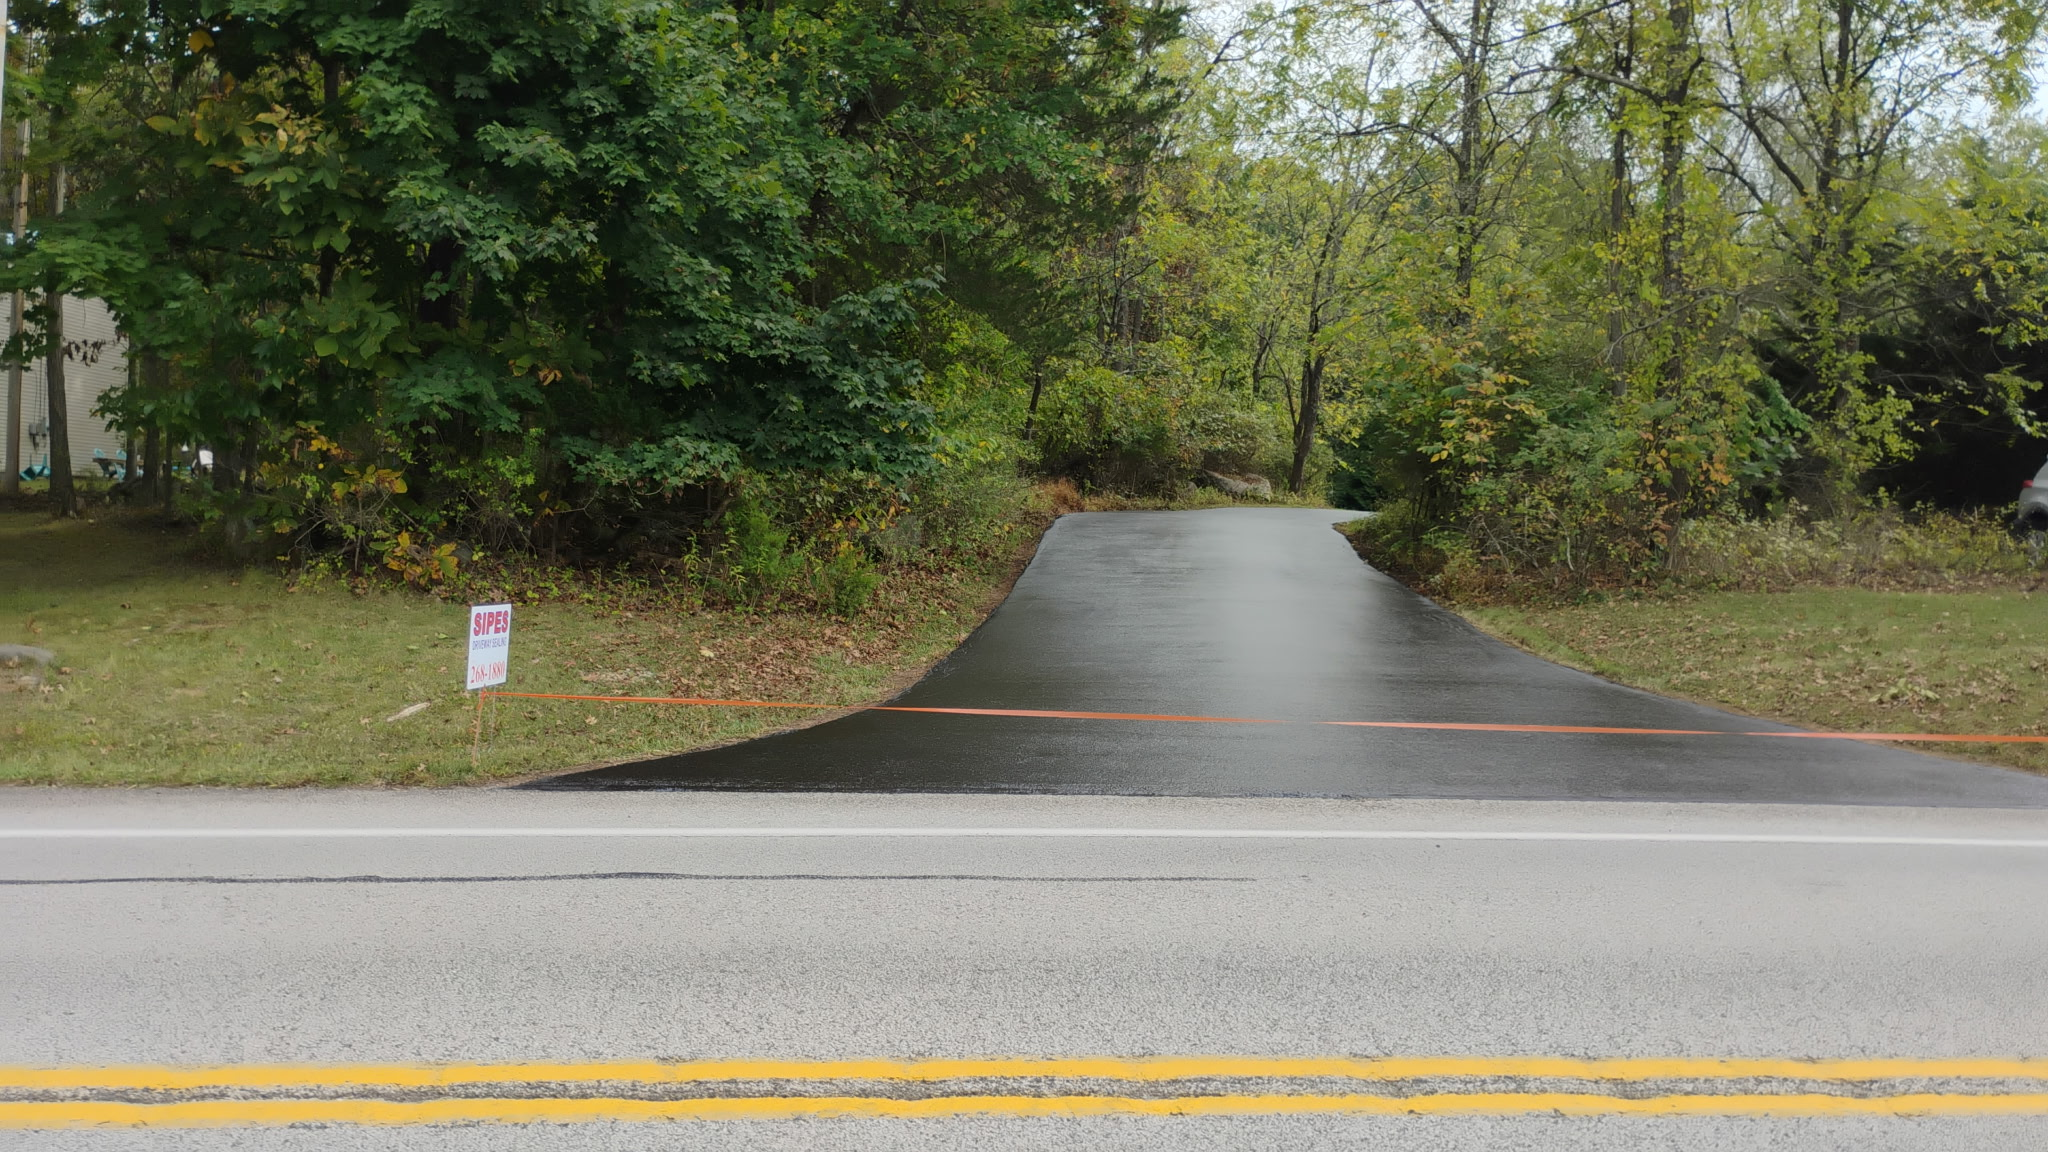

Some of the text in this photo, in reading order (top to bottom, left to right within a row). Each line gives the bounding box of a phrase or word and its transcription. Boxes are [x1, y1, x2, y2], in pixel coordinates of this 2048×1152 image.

[473, 610, 509, 636] SIPES
[472, 639, 491, 650] DRIVEWAY
[470, 661, 505, 684] 268-1880
